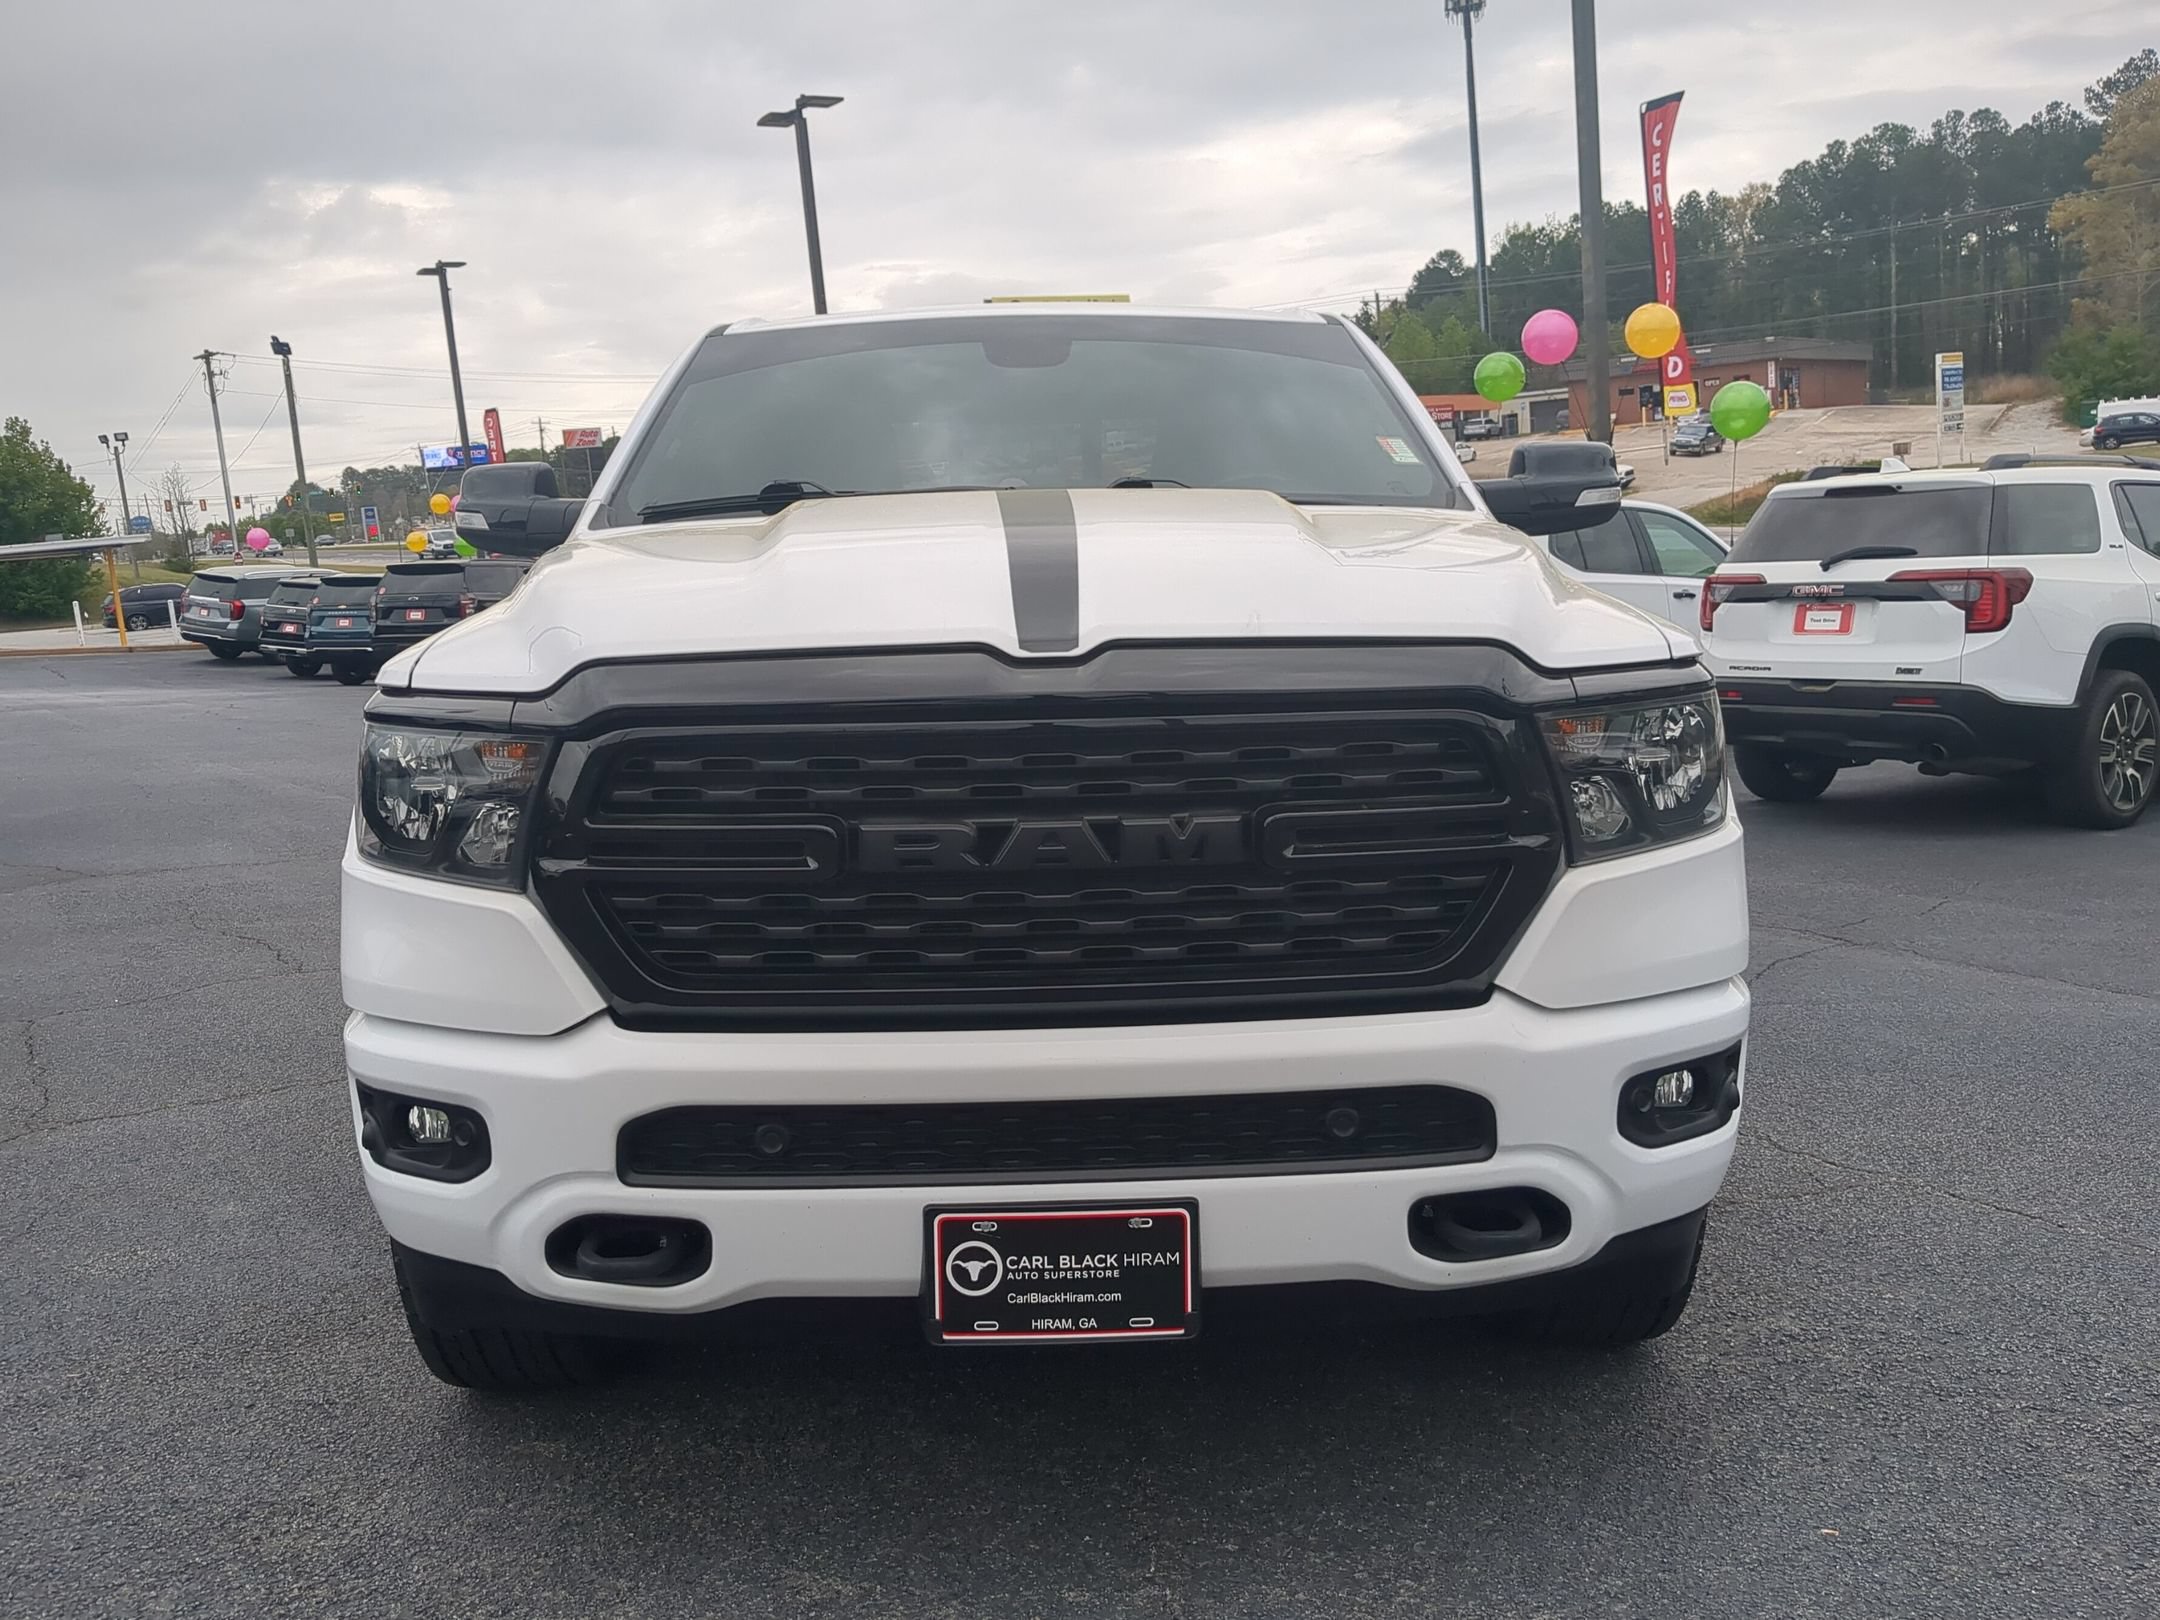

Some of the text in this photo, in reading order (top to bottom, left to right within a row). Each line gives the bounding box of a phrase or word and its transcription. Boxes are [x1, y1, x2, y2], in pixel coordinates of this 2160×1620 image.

[1705, 379, 1720, 387] OPEN
[580, 430, 598, 438] Auto
[1792, 584, 1845, 597] GMC
[858, 815, 1243, 869] RAM
[1006, 1252, 1180, 1270] CARL BLACK HIRAM
[1006, 1269, 1121, 1280] AUTO SUPERSTORE
[1007, 1292, 1122, 1304] CarlBlackHiram.com
[1031, 1317, 1098, 1330] HIRAM, GA
